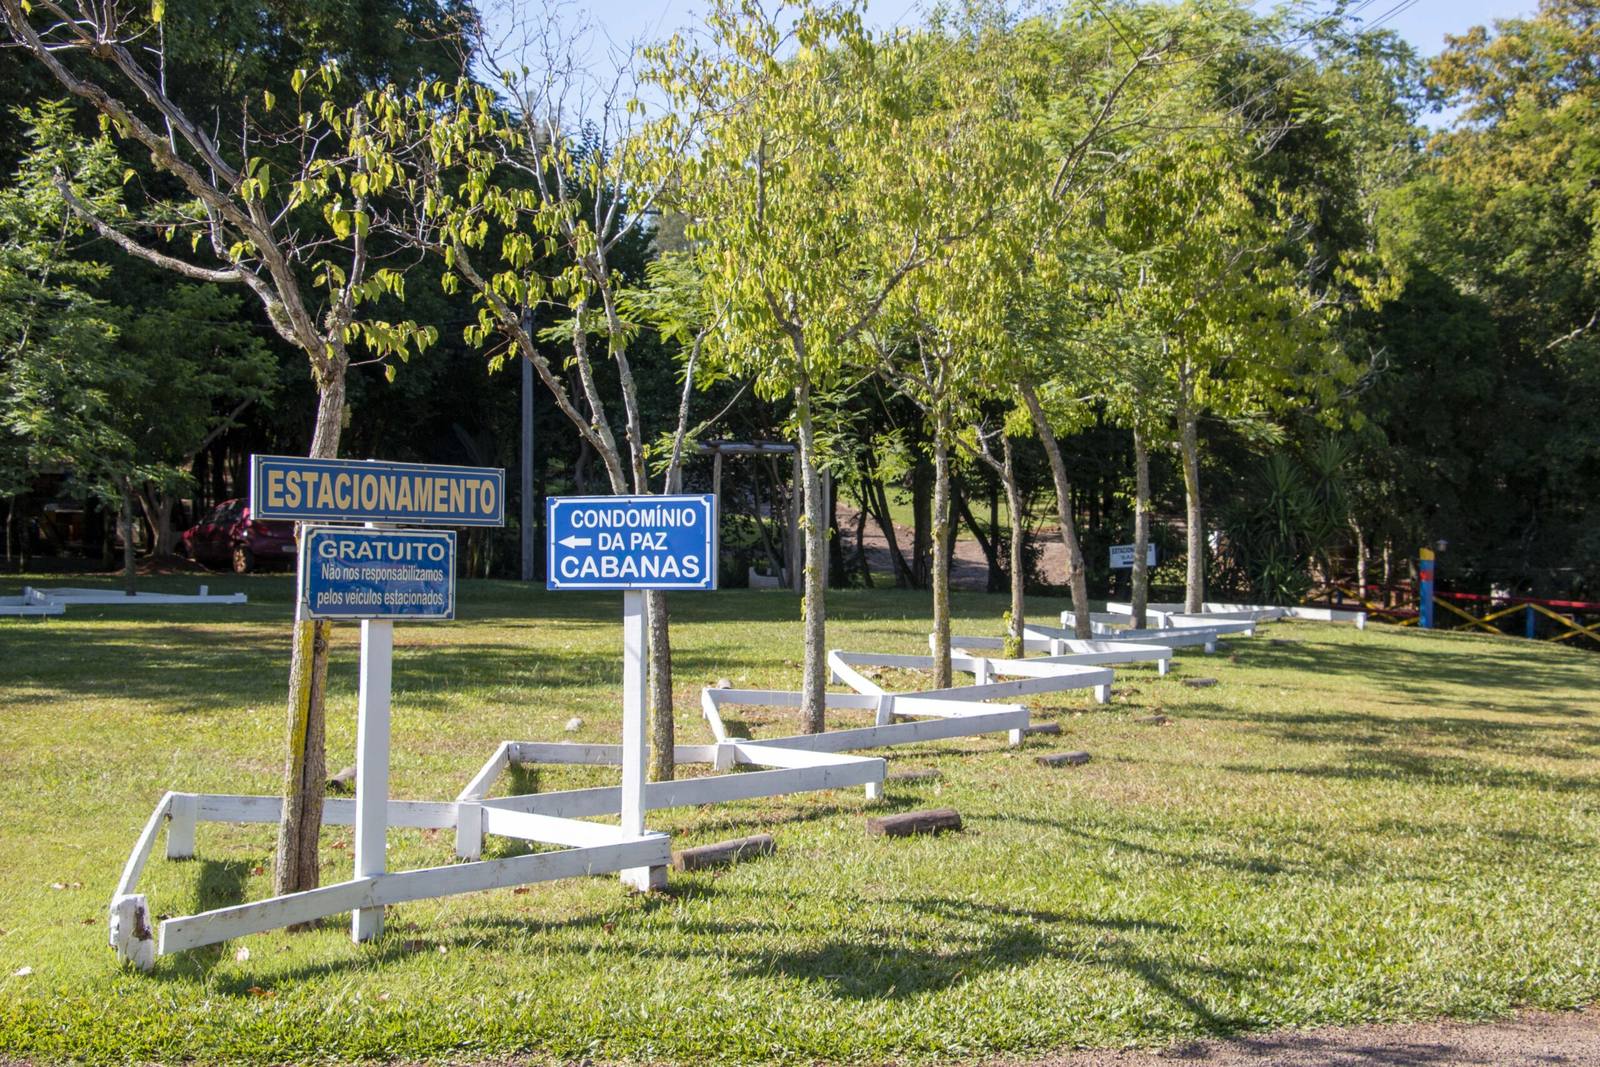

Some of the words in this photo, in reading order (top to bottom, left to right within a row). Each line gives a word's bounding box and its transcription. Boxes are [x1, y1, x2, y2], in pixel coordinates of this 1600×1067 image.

[268, 470, 496, 514] ESTACIONAMENTO
[570, 504, 696, 528] CONDOMÍNIO
[318, 540, 445, 561] GRATUITO
[598, 532, 625, 551] DA
[630, 532, 668, 551] PAZ
[321, 563, 342, 580] Não
[343, 567, 360, 580] nos
[361, 565, 444, 584] responsabilizamos
[560, 555, 700, 578] CABANAS
[317, 588, 343, 608] pelos
[345, 587, 383, 605] veículos
